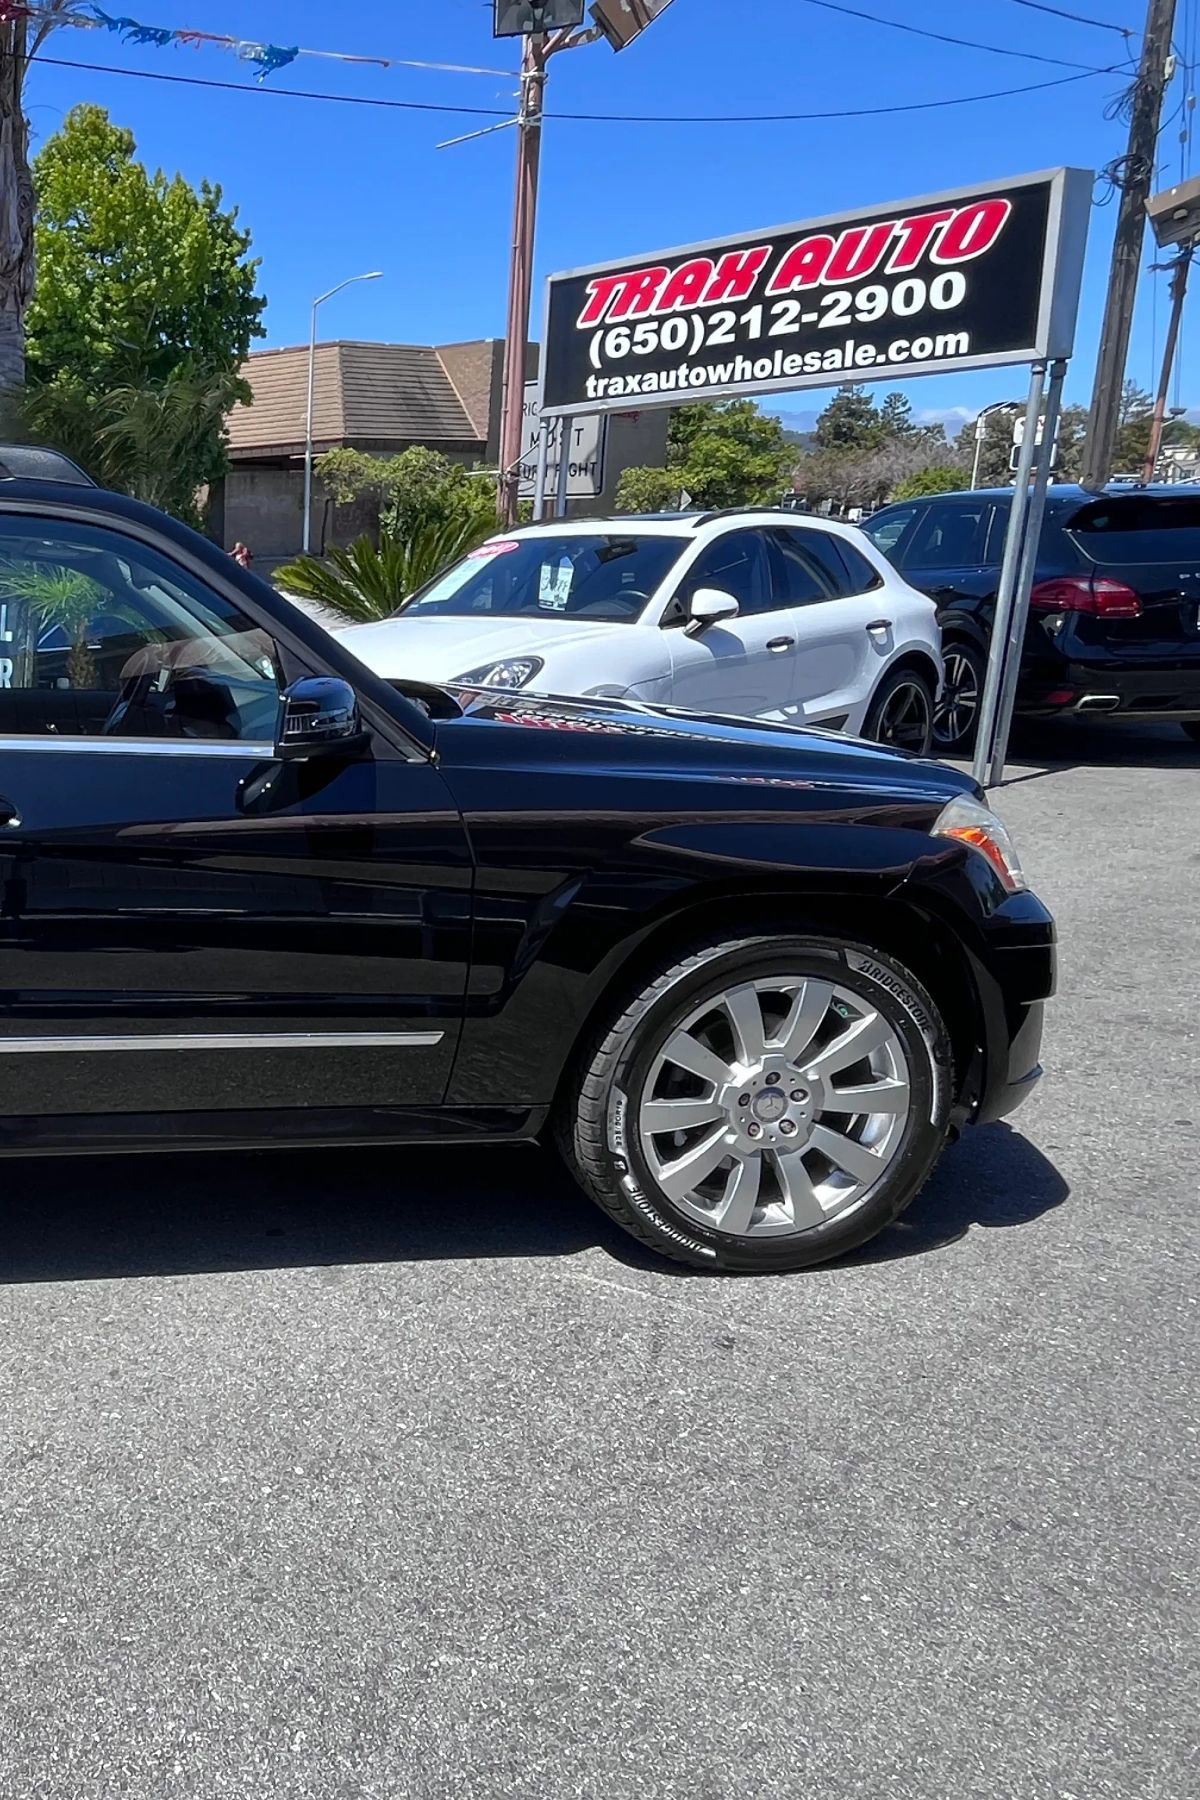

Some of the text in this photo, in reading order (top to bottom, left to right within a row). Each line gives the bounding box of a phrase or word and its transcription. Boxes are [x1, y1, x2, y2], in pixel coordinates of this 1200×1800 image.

[576, 198, 1012, 330] TRAX AUTO
[588, 271, 967, 369] (650)212-2900
[586, 331, 969, 398] traxautowholesale.com
[529, 428, 584, 448] MUT
[555, 462, 598, 478] RGHT
[858, 960, 933, 1035] BRIDGESTONE
